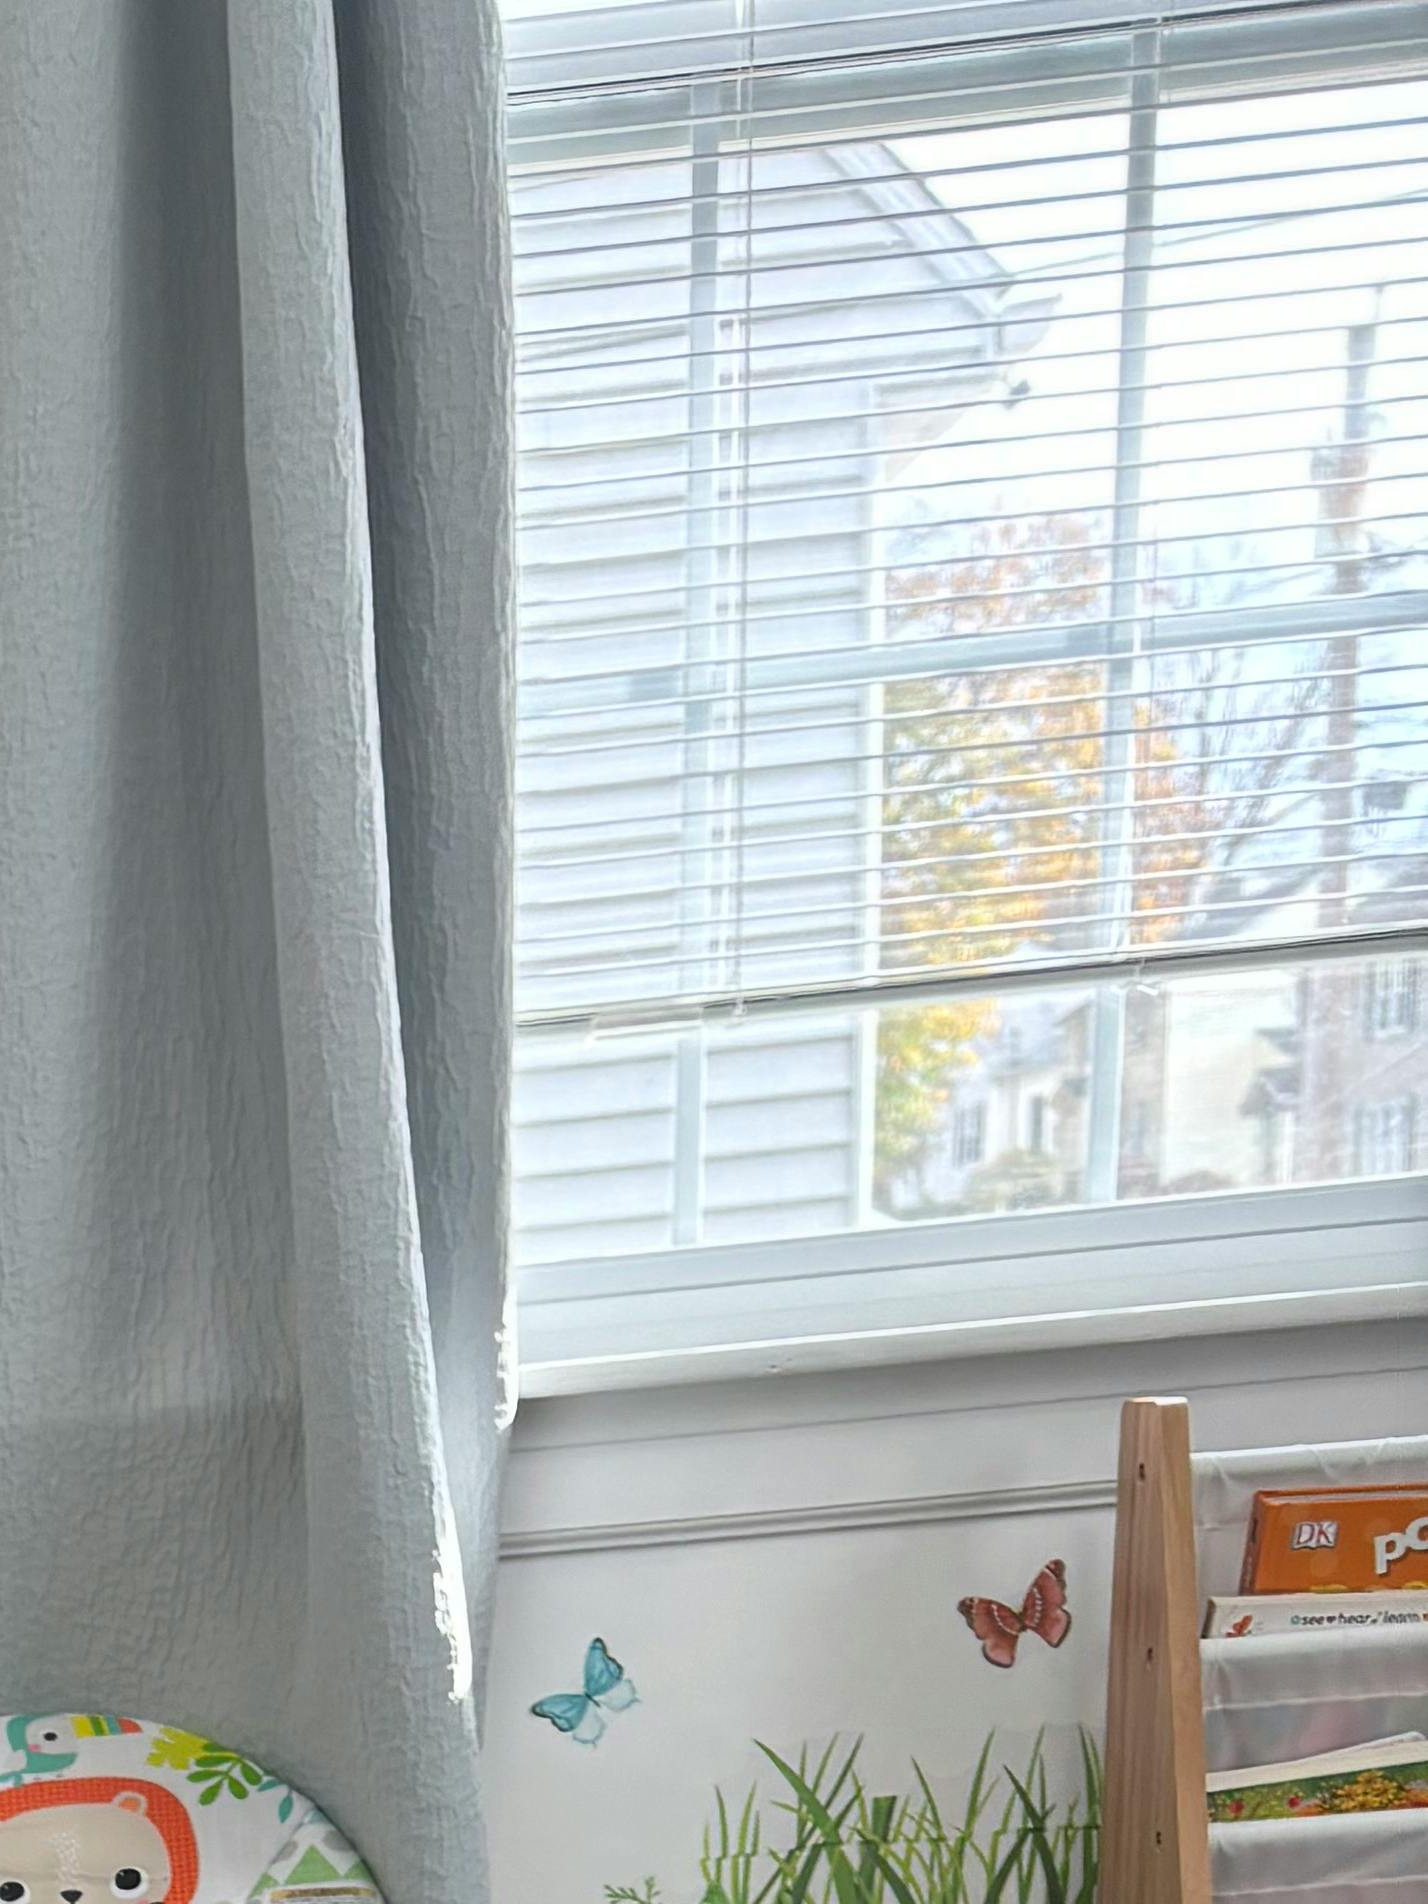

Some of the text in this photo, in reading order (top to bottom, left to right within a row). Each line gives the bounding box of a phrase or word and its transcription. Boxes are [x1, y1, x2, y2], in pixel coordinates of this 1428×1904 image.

[1295, 1522, 1336, 1546] DK
[1302, 1611, 1420, 1625] see hear learn
